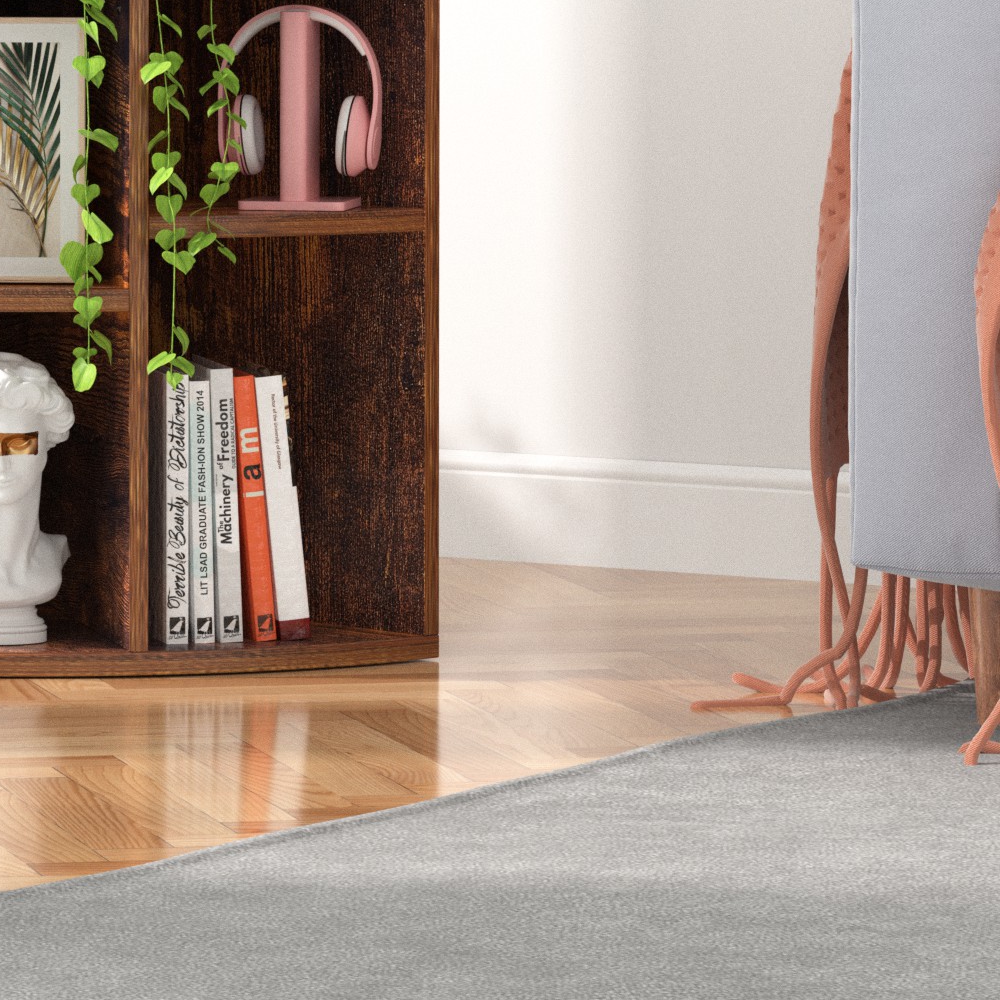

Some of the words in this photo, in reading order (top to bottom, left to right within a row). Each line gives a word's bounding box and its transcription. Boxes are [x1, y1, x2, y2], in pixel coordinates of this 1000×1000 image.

[196, 390, 204, 411] 2014
[196, 414, 205, 444] SHOW
[216, 399, 229, 461] Freedom
[168, 475, 185, 490] of
[197, 447, 206, 492] FASH-ION
[198, 496, 208, 550] GRADUATE
[220, 474, 233, 544] Machinery
[167, 552, 186, 609] Terrible
[199, 553, 208, 578] LSAD
[199, 581, 208, 595] LIT
